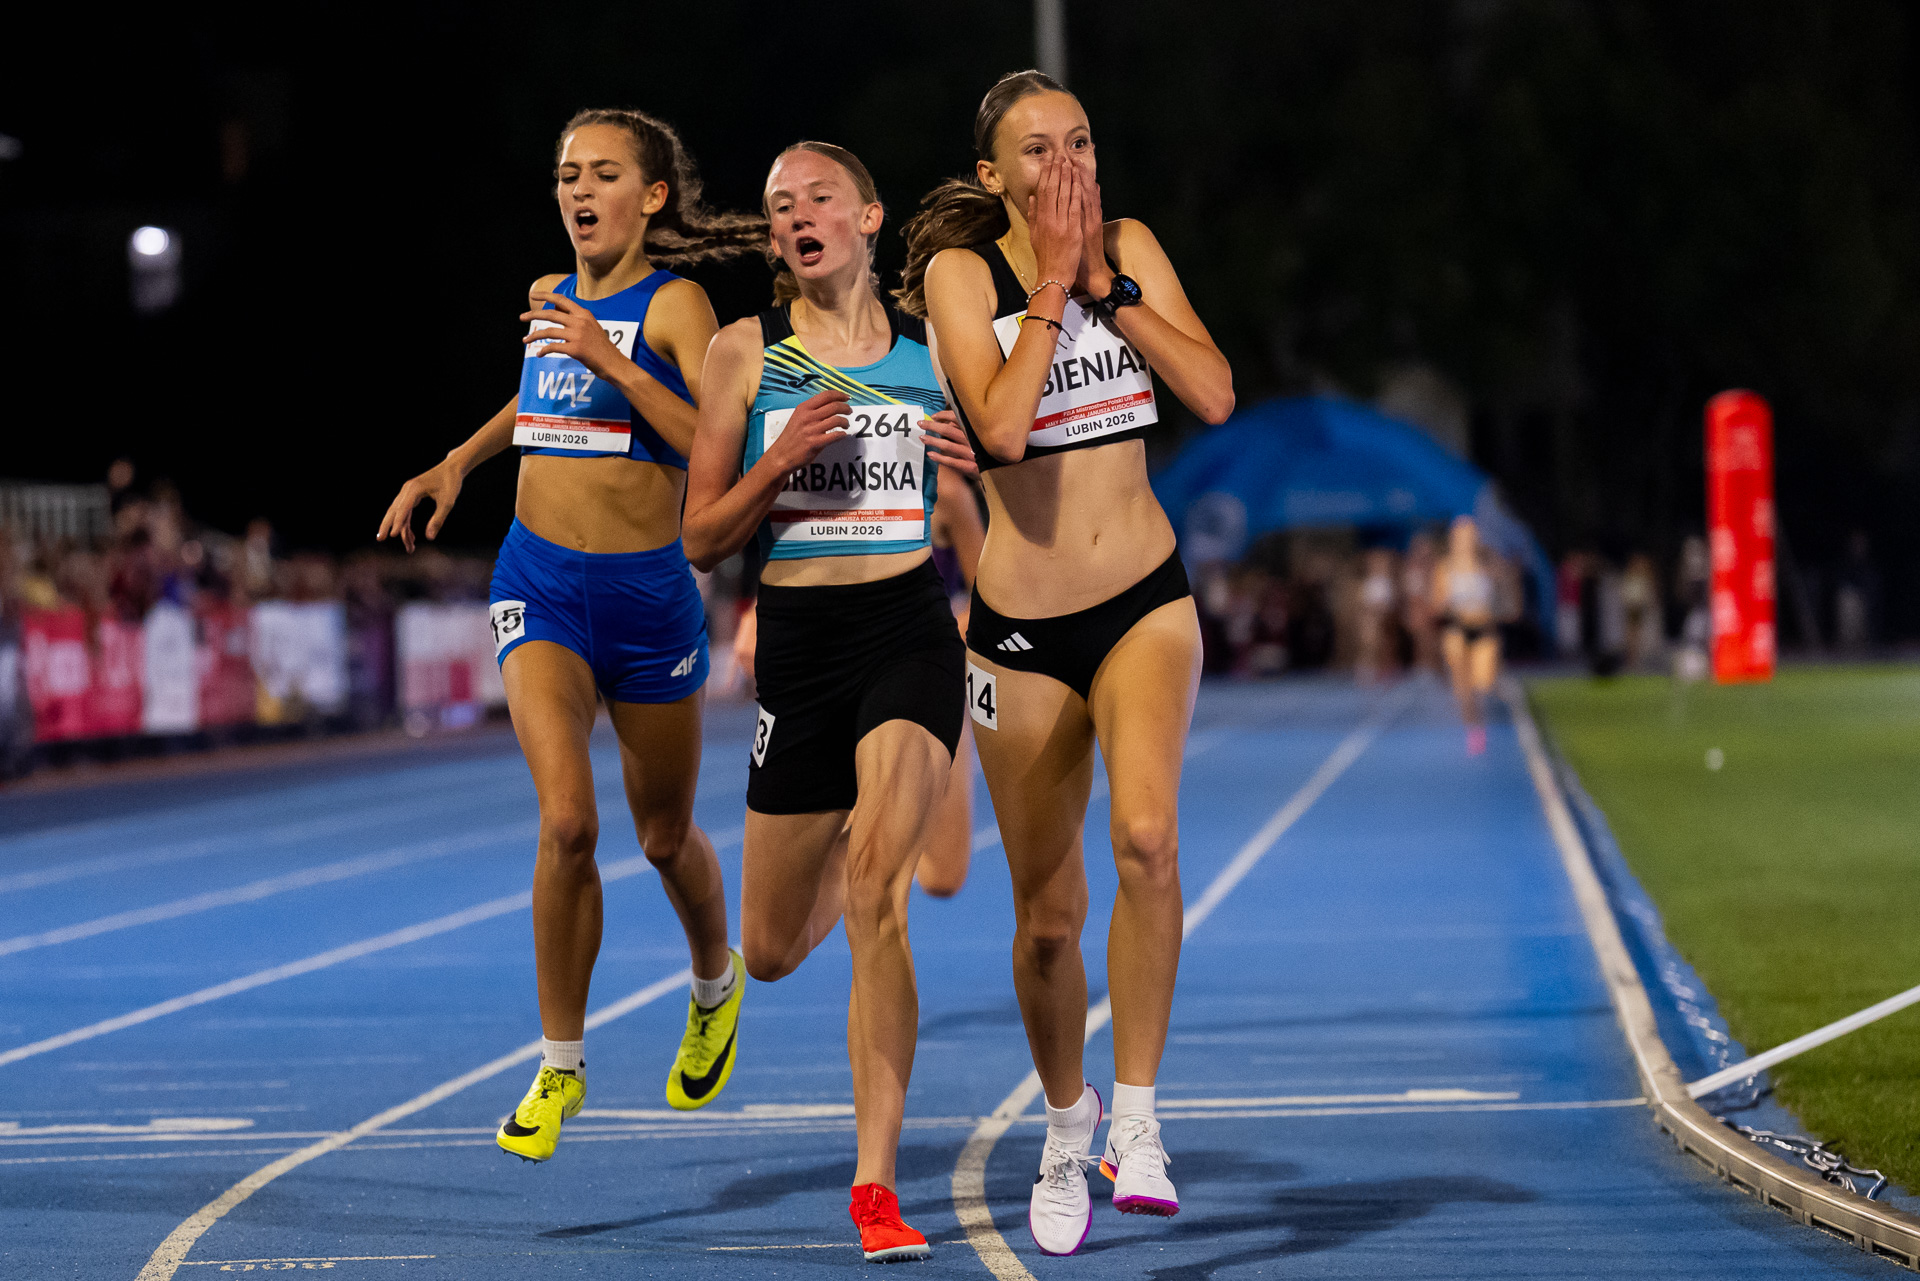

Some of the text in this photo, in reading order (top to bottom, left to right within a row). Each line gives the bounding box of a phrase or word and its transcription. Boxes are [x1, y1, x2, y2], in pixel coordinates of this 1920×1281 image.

[537, 368, 596, 408] WĄŻ
[1076, 402, 1108, 414] Mistrzostwa
[1108, 397, 1124, 406] Polski
[1086, 408, 1111, 419] JANUSZA
[854, 412, 912, 438] 264
[1066, 412, 1135, 437] LUBIN 2026
[531, 432, 589, 445] LUBIN 2026
[810, 525, 883, 536] LUBIN 2026
[490, 606, 523, 644] 15
[670, 647, 699, 677] 4F
[966, 671, 996, 720] 14
[756, 718, 768, 756] 3
